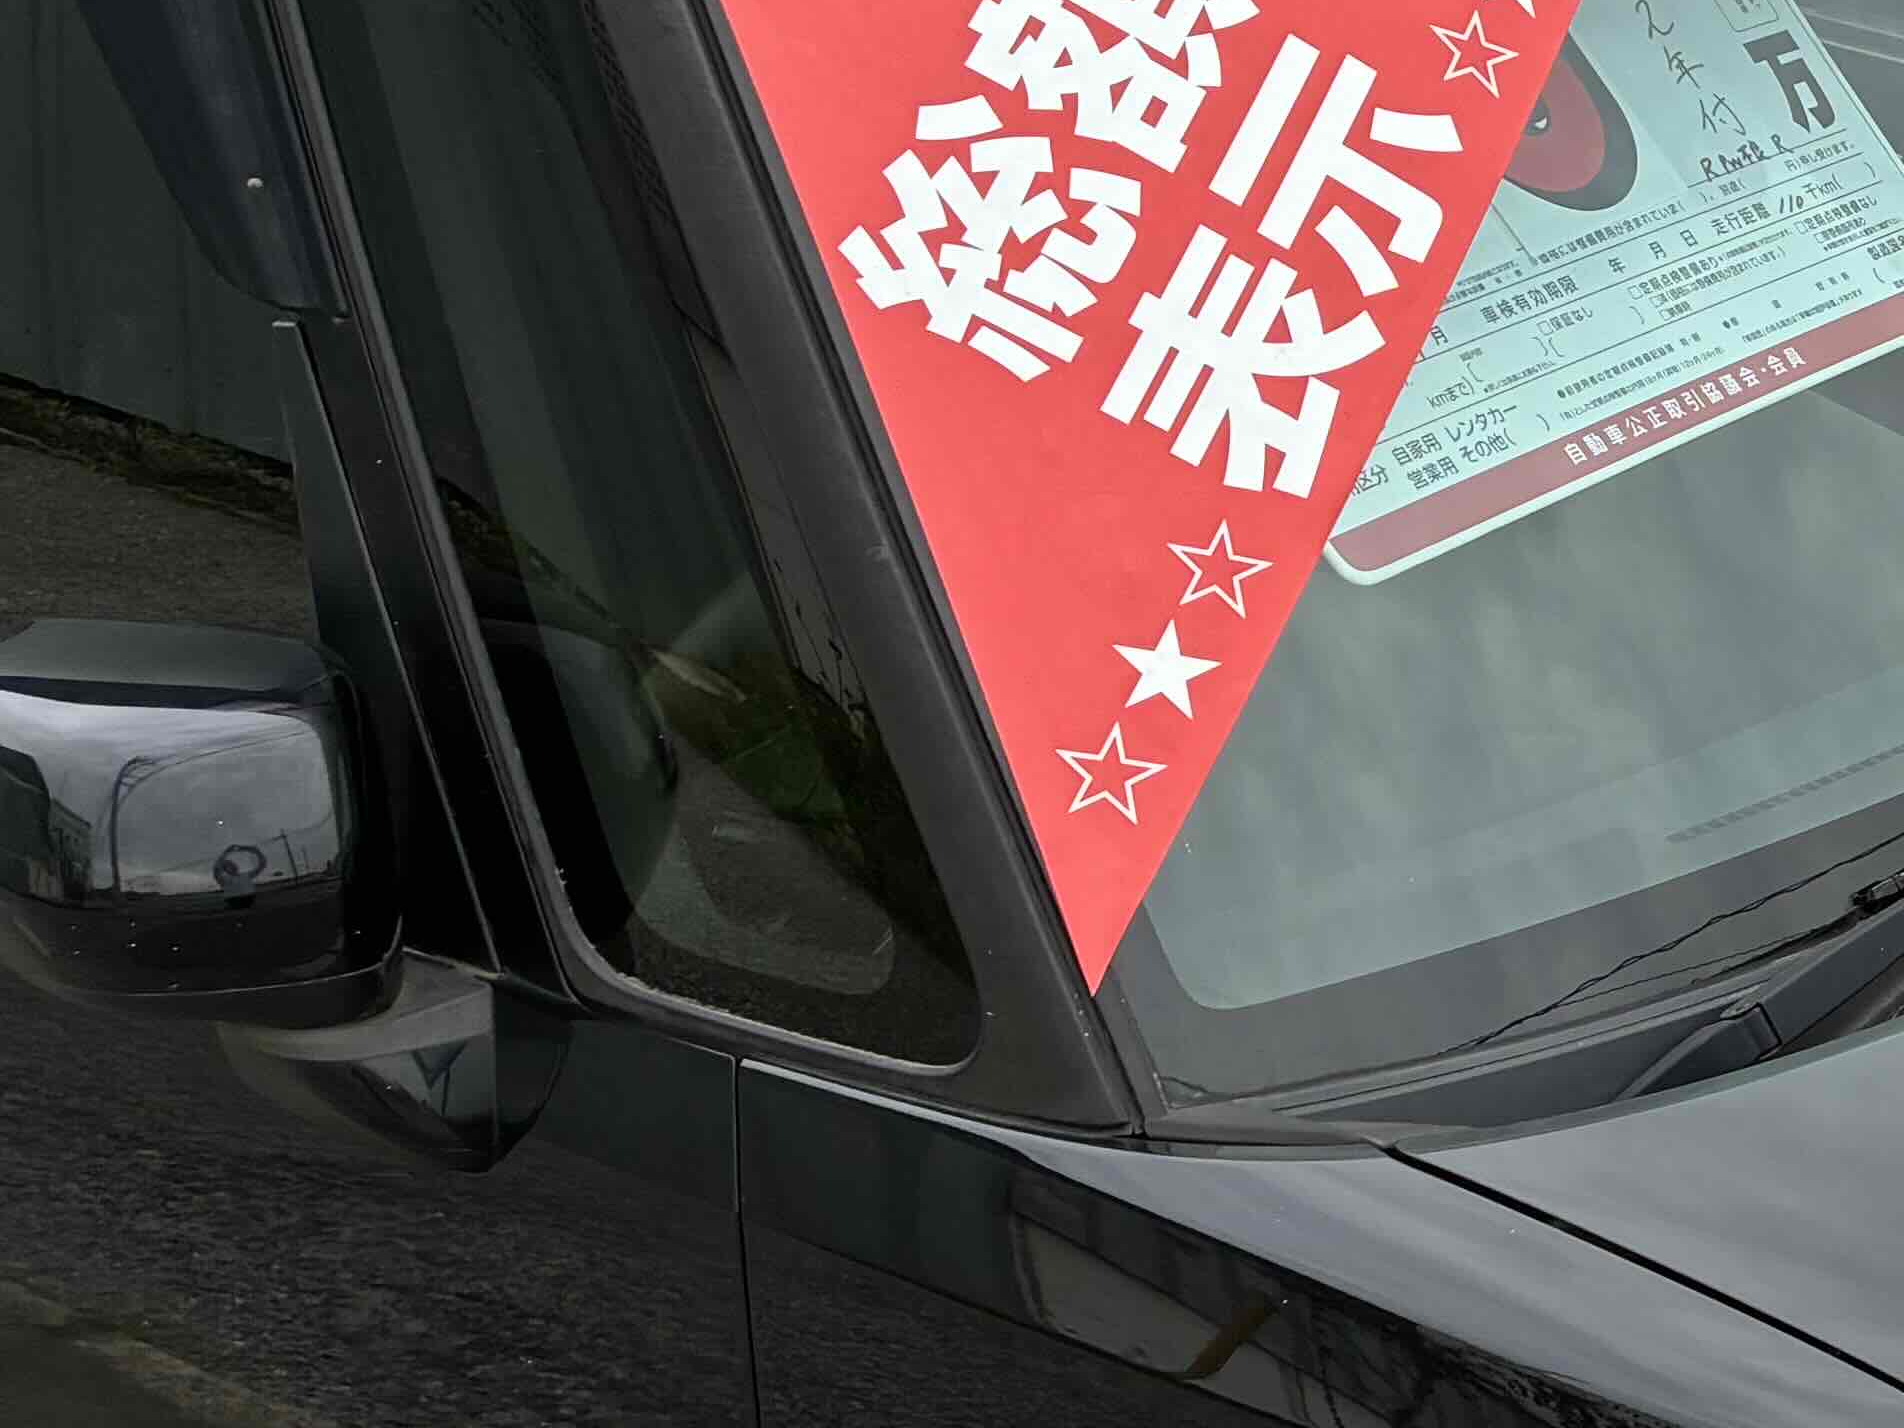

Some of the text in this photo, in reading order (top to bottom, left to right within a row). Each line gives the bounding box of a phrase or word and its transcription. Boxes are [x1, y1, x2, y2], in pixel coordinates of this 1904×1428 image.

[1743, 29, 1836, 133] 万
[1101, 33, 1464, 500] 表示
[1480, 274, 1580, 324] 車検有効期限
[1608, 257, 1626, 275] 年
[1650, 241, 1667, 260] 月
[1680, 229, 1698, 248] 日
[1712, 201, 1772, 236] 走行距離
[1391, 404, 1518, 465] 自家用 レンタカー
[1562, 346, 1807, 466] 自動車公正取引協議会・会員
